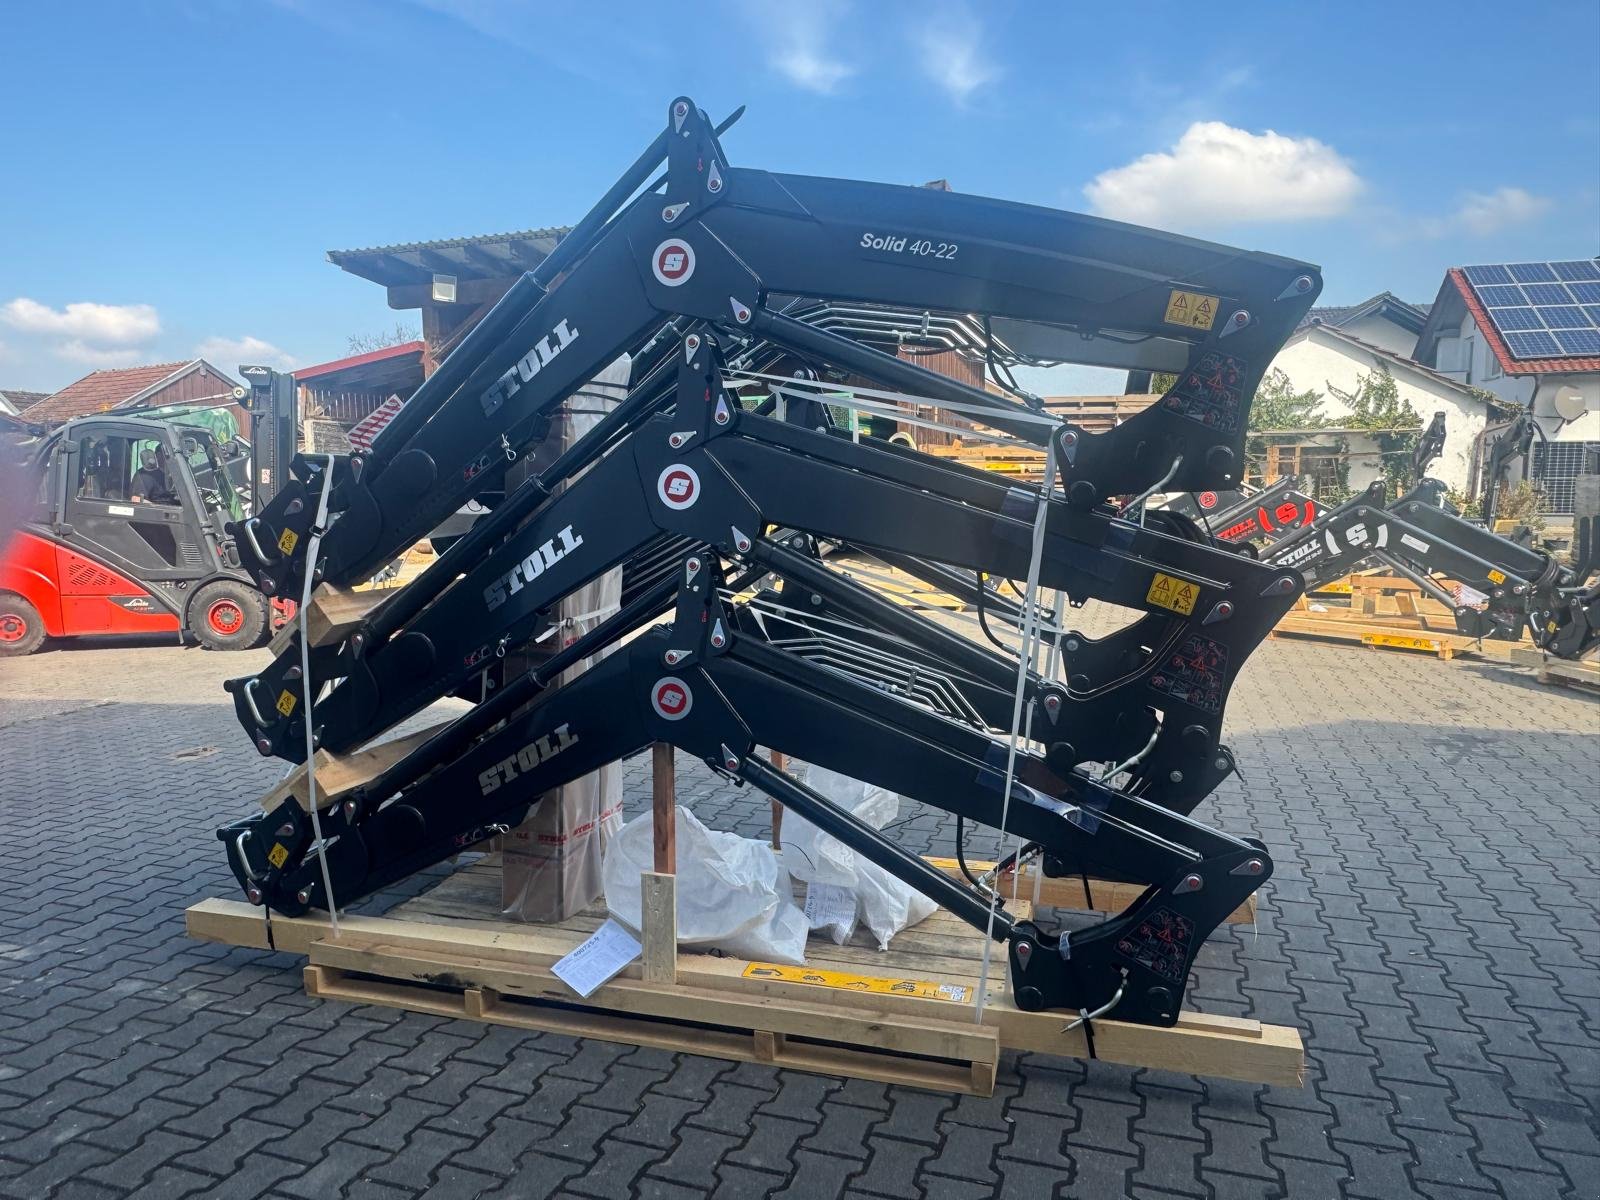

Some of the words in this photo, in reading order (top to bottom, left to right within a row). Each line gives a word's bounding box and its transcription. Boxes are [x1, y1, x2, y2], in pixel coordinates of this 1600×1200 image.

[859, 231, 907, 253] Solid
[908, 237, 959, 261] 40-22
[480, 317, 580, 417] STOLL
[483, 524, 583, 612] STOLL
[1276, 538, 1321, 565] STOLL
[477, 722, 579, 797] STOLL
